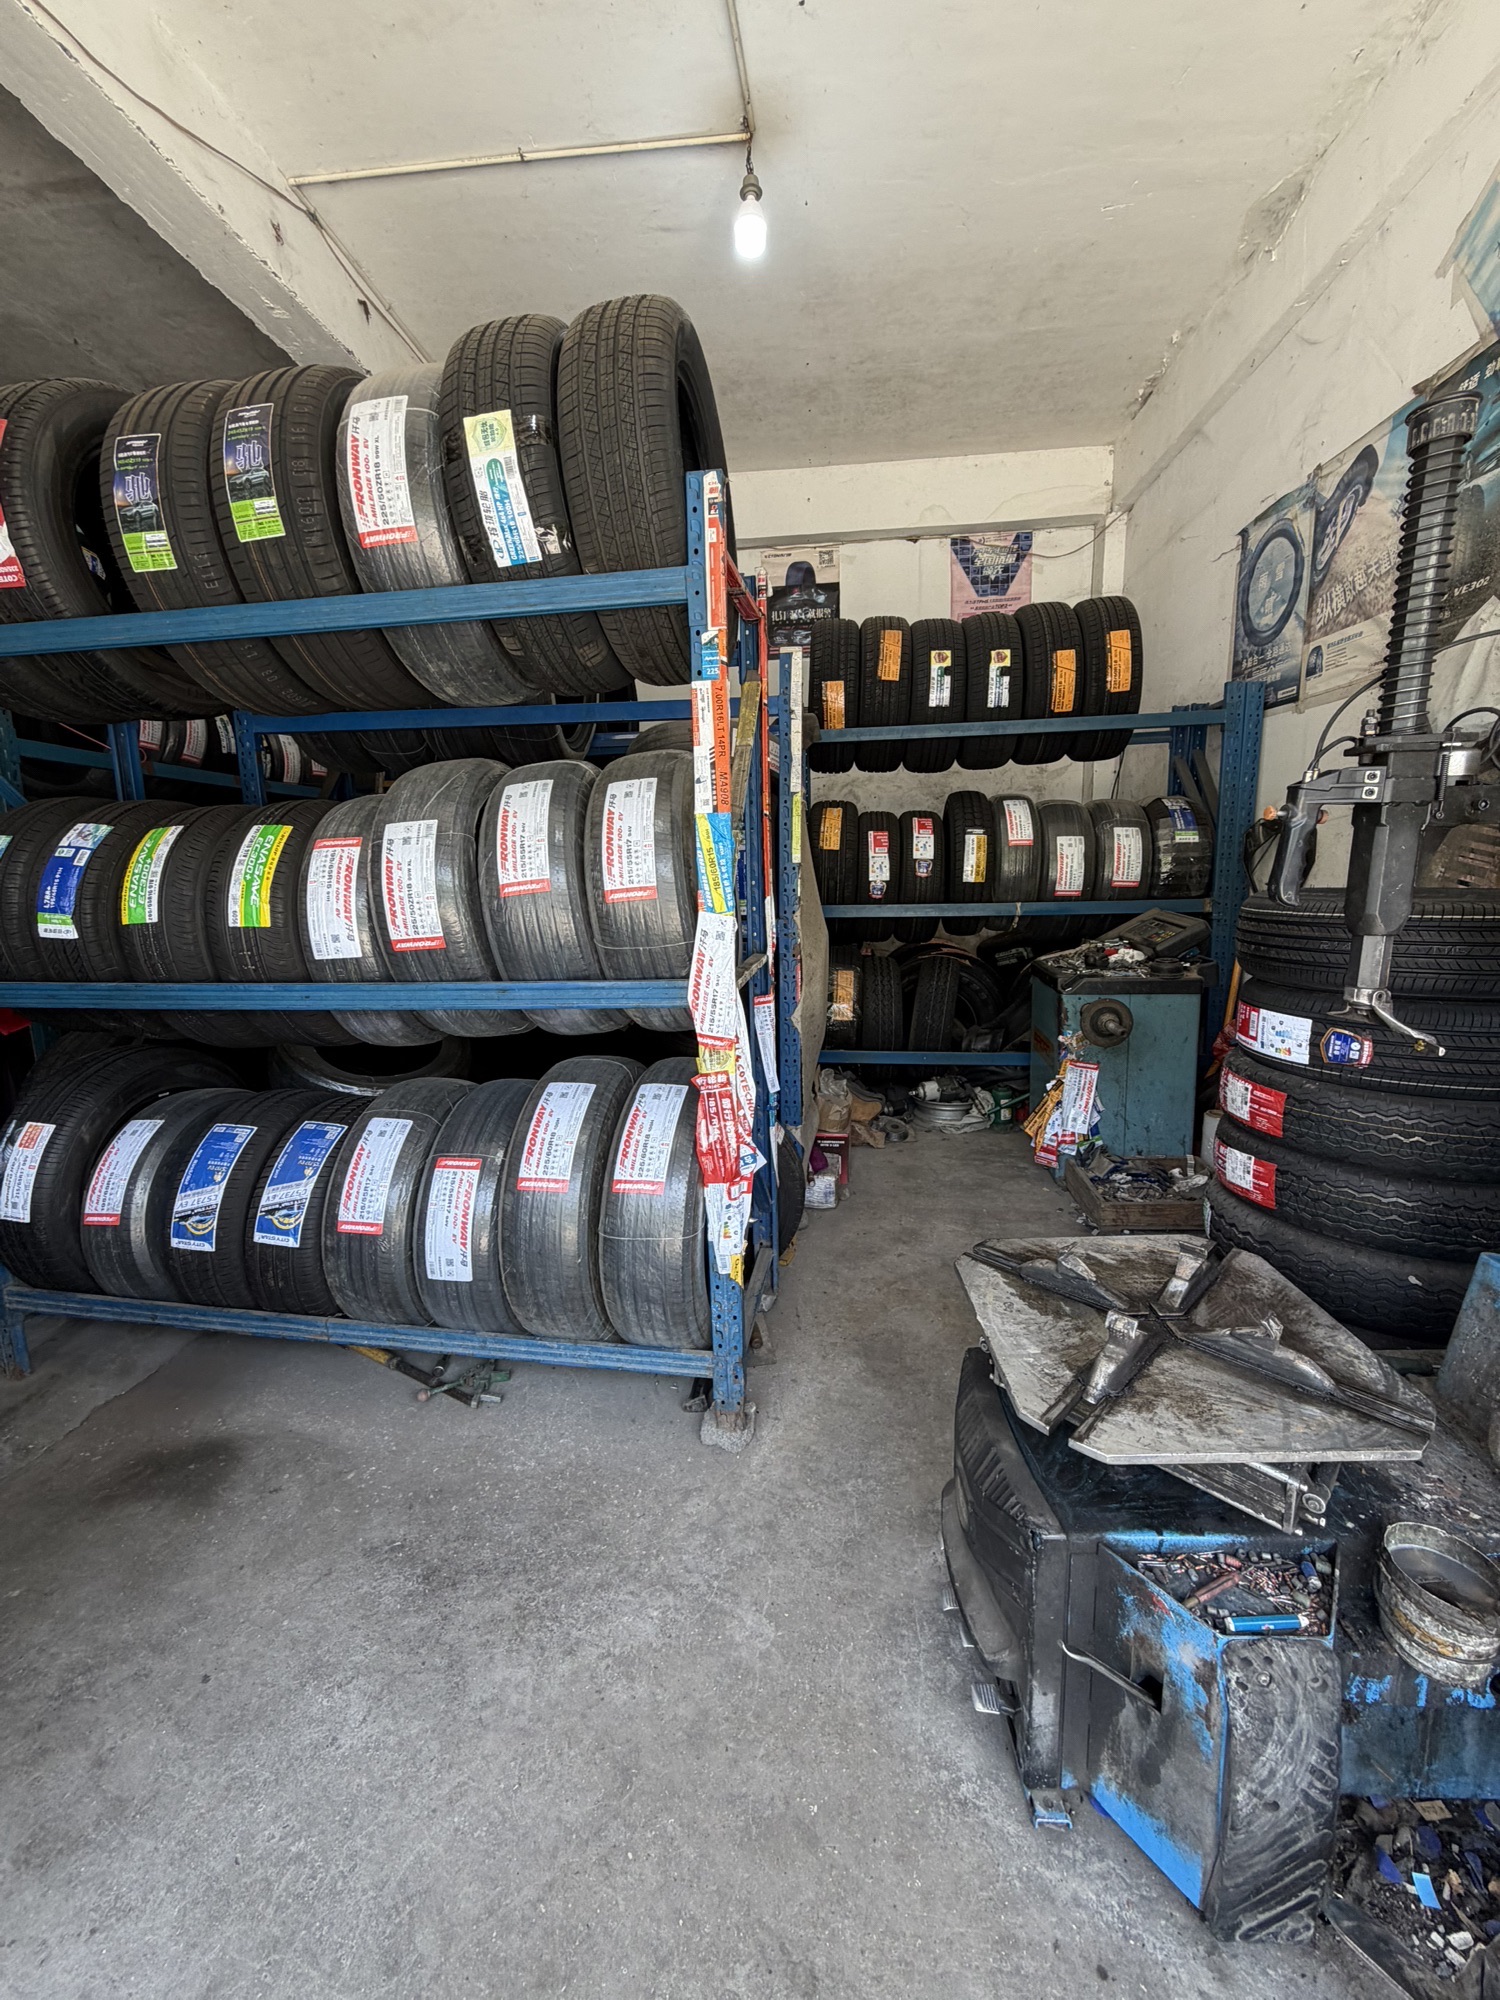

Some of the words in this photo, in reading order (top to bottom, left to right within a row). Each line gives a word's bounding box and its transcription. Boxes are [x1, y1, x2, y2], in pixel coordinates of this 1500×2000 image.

[351, 434, 369, 520] FRONWAY
[1453, 576, 1490, 597] VE302
[715, 686, 725, 732] 7.00R16LT
[718, 735, 727, 758] 14PR
[719, 772, 730, 806] MA908
[244, 837, 263, 881] EC300+
[500, 807, 510, 869] FRONWAY
[606, 808, 616, 878] FRONWAY
[706, 847, 721, 891] 185/60R15
[129, 839, 152, 909] ENASAVE
[138, 858, 151, 904] EC300+
[250, 835, 275, 908] ENASAVE
[344, 857, 354, 924] FRONWAY
[385, 855, 399, 926] FRONWAY
[524, 1104, 546, 1166] FRONWAY
[619, 1106, 640, 1168] FRONWAY
[177, 1200, 189, 1209] EV
[341, 1145, 365, 1211] FRONWAY
[460, 1179, 473, 1251] FRONWAY
